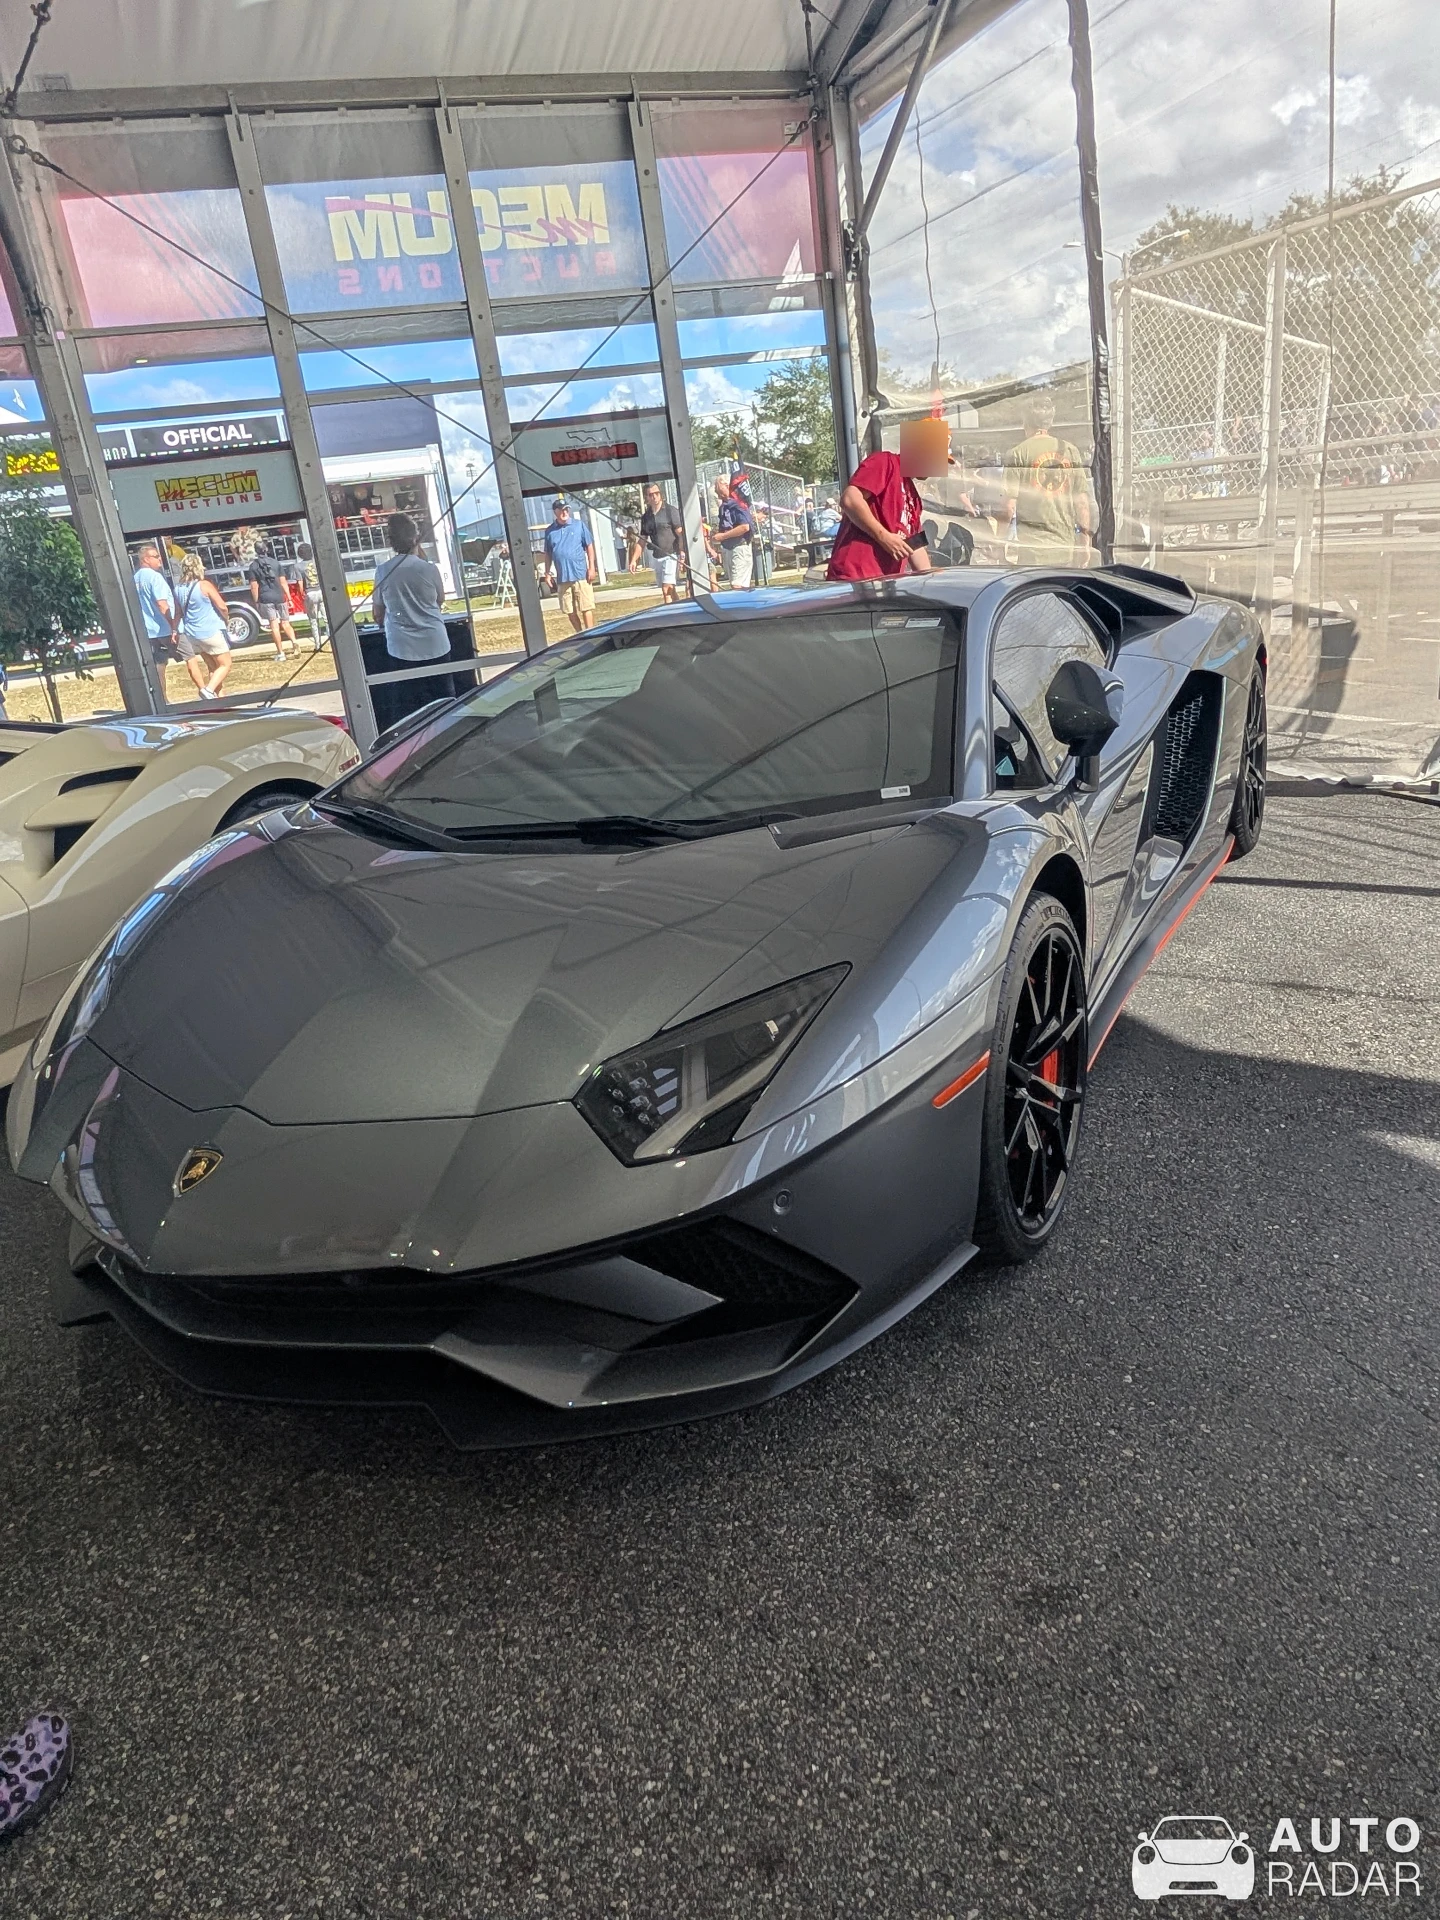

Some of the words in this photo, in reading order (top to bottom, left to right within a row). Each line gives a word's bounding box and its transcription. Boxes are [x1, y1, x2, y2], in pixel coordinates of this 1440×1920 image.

[163, 423, 253, 447] OFFICIAL
[551, 441, 639, 467] KISSIMMEE
[154, 469, 261, 503] MECUM
[160, 493, 263, 512] AUCTIONS
